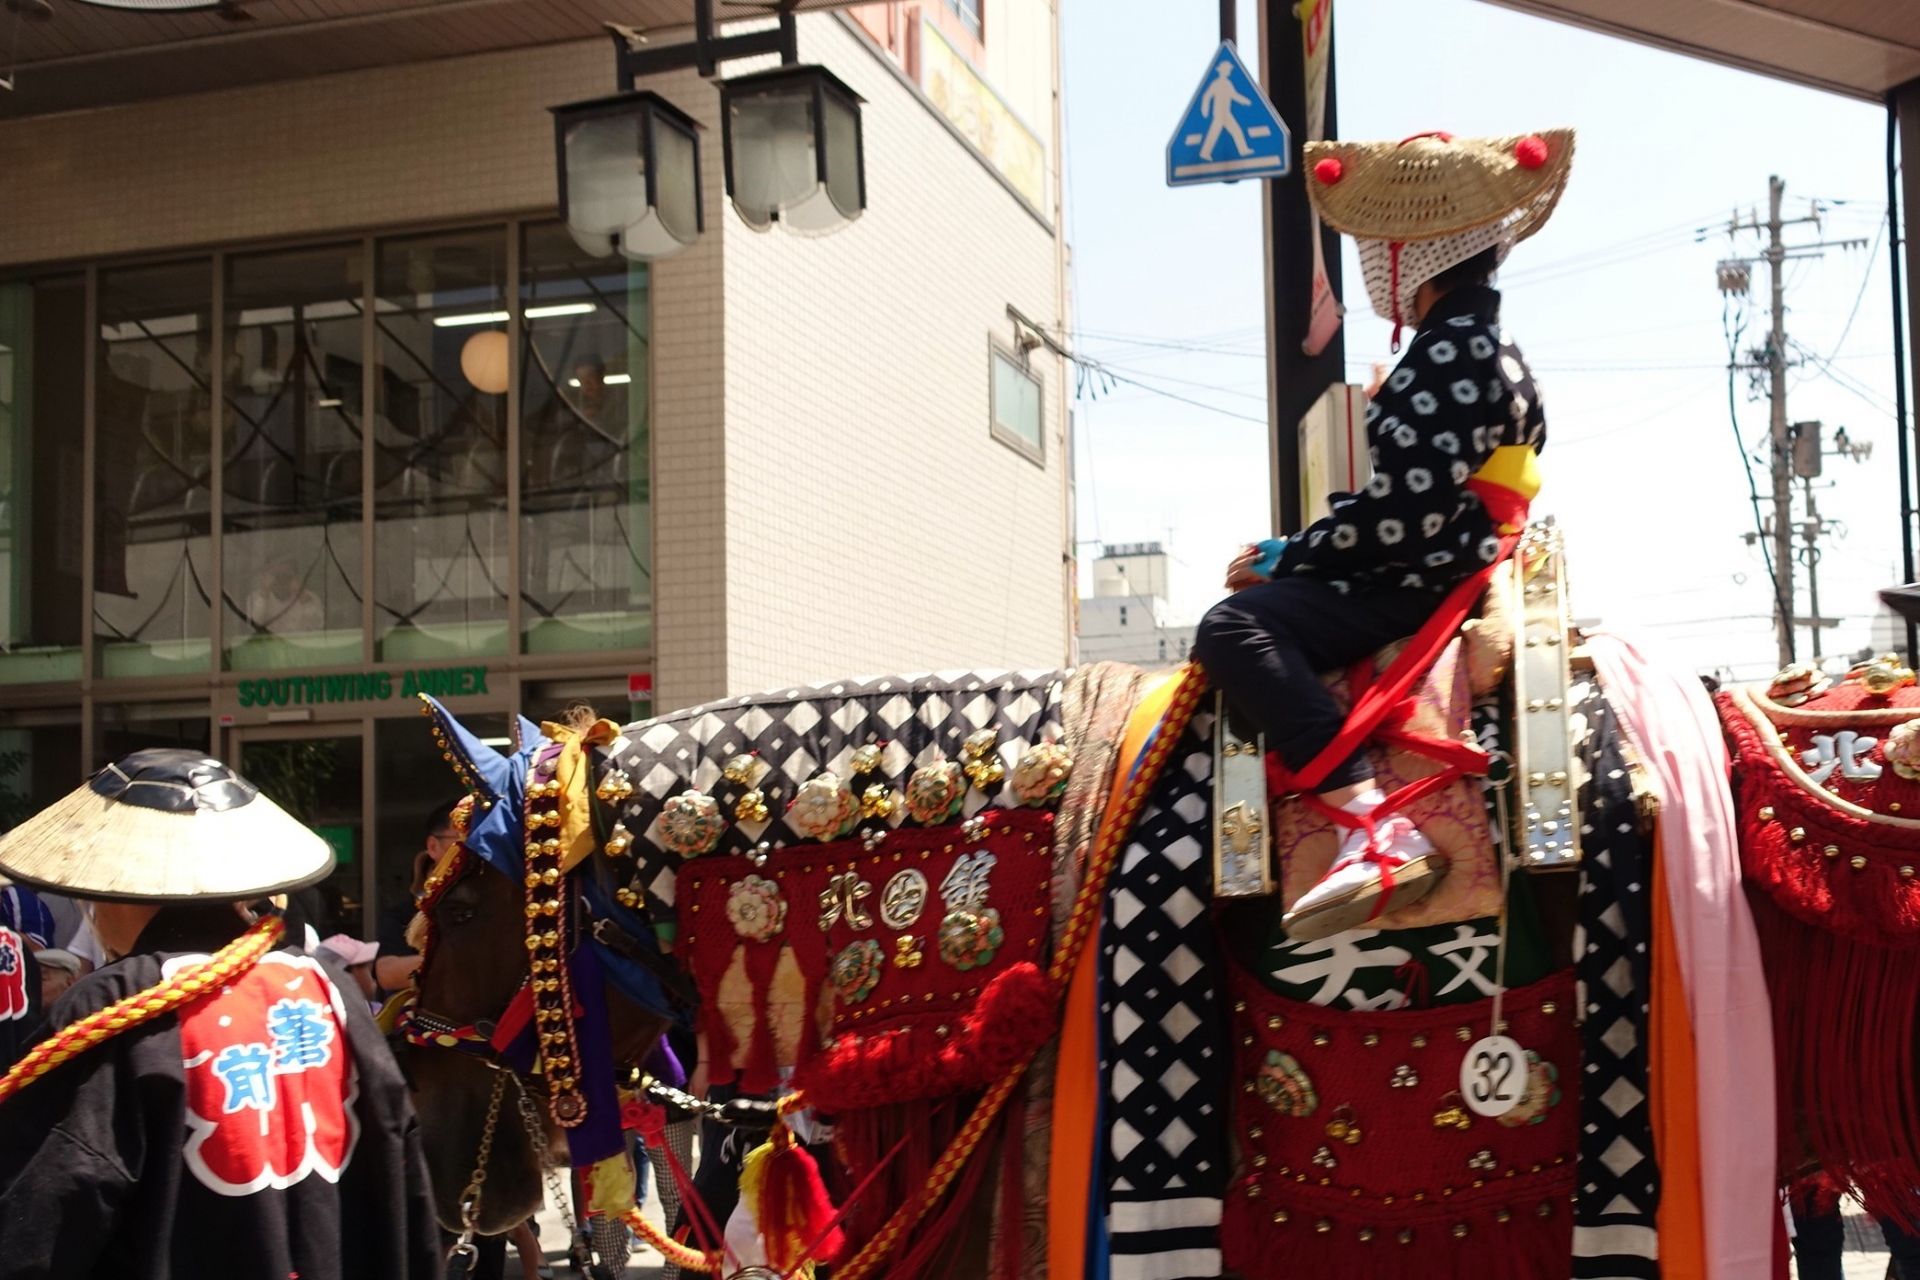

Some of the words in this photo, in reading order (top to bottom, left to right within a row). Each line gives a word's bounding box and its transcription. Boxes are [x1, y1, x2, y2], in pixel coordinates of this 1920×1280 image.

[238, 673, 392, 707] SOUTHWING
[401, 666, 488, 698] ANNEX
[1427, 924, 1509, 997] 文
[1472, 1050, 1514, 1102] 32
